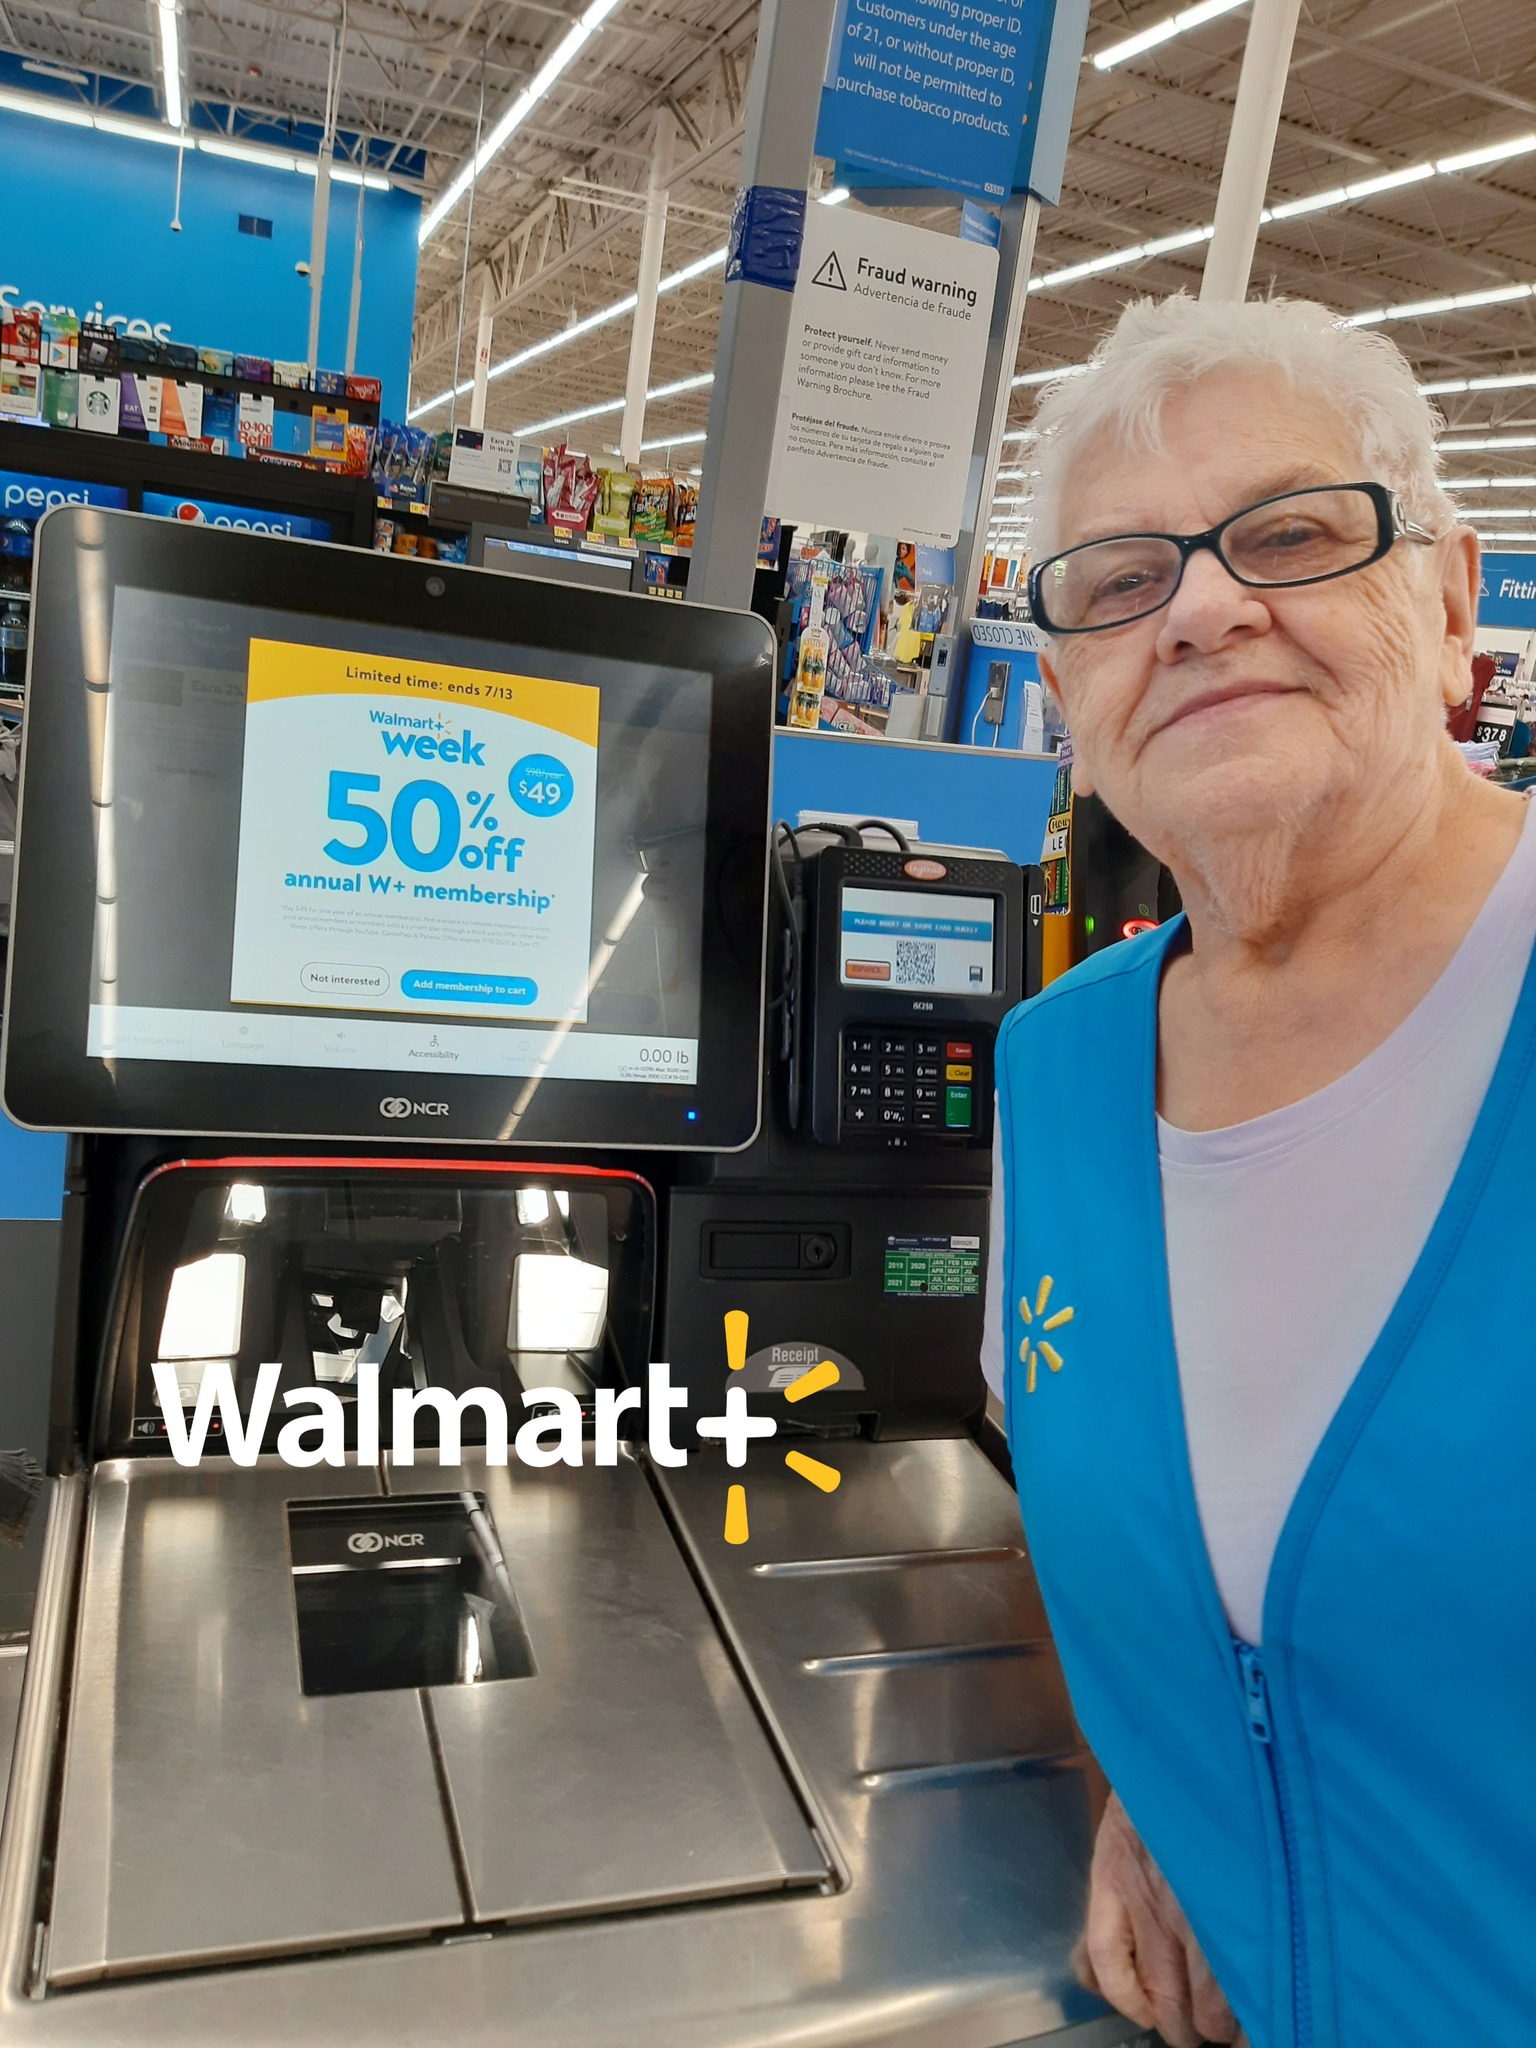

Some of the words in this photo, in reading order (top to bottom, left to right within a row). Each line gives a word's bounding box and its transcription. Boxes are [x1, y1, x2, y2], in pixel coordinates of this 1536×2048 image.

[856, 0, 925, 29] Customers
[929, 21, 967, 41] under
[970, 31, 990, 49] the
[993, 41, 1016, 58] age
[961, 6, 1005, 28] proper
[1007, 16, 1021, 34] ID.
[847, 22, 863, 37] of
[863, 26, 882, 46] 21,
[886, 36, 900, 48] or
[903, 41, 953, 65] without
[955, 57, 998, 78] proper
[1000, 67, 1014, 86] ID,
[854, 53, 876, 70] will
[879, 61, 901, 77] not
[904, 64, 921, 82] be
[923, 75, 987, 102] permitted
[989, 92, 1002, 106] to
[836, 77, 896, 103] purchase
[900, 92, 950, 118] tobacco
[952, 110, 1009, 136] products.
[857, 257, 906, 285] Fraud
[911, 275, 977, 307] warning
[853, 282, 919, 308] Advertencia
[921, 299, 935, 312] de
[937, 302, 971, 320] fraude
[804, 324, 836, 339] Protect
[837, 334, 873, 347] yourself.
[874, 339, 900, 352] Never
[901, 348, 920, 357] send
[921, 352, 949, 366] money
[812, 342, 845, 354] provide
[846, 348, 861, 358] gift
[863, 353, 881, 362] card
[882, 355, 929, 372] information
[931, 366, 940, 375] to
[800, 352, 838, 366] someone
[840, 361, 855, 370] you
[857, 363, 878, 375] don't
[880, 367, 903, 380] know.
[905, 372, 919, 383] For
[920, 378, 941, 388] more
[796, 376, 831, 394] Warning
[832, 384, 872, 400] Brochure.
[798, 363, 847, 381] information
[848, 375, 875, 387] please
[876, 382, 890, 391] see
[892, 384, 905, 394] the
[907, 386, 930, 399] Fraud
[125, 404, 139, 412] EAT
[240, 421, 273, 434] 10-100
[824, 419, 835, 427] del
[836, 421, 859, 432] fraude.
[861, 426, 882, 436] Nunca
[901, 435, 922, 444] dinero
[928, 441, 950, 450] provea
[238, 432, 273, 448] Refill
[789, 423, 799, 431] los
[831, 431, 840, 439] de
[849, 435, 871, 445] tarjeta
[872, 439, 881, 447] de
[882, 442, 903, 451] regalo
[908, 446, 931, 456] alguien
[786, 445, 815, 455] panfleto
[816, 449, 856, 463] Advertencia
[867, 458, 889, 469] fraude.
[5, 484, 90, 508] pepsi
[972, 625, 1014, 645] CLOSED
[346, 666, 400, 683] Limited
[406, 675, 442, 690] time:
[448, 683, 479, 695] ends
[485, 685, 512, 699] 7/13
[381, 730, 486, 766] week
[519, 781, 562, 806] $49
[459, 836, 526, 873] off
[284, 873, 361, 893] annual
[368, 876, 406, 895] W+
[853, 917, 876, 926] PLEASE
[310, 972, 328, 983] Not
[330, 974, 380, 987] interested
[412, 978, 433, 989] Add
[434, 981, 493, 995] membership
[494, 985, 506, 994] to
[507, 986, 526, 995] cart
[408, 1049, 459, 1061] Accessibility
[852, 1041, 857, 1050] 1
[885, 1043, 891, 1052] 2
[918, 1044, 923, 1053] 3
[640, 1048, 672, 1063] 0.00
[676, 1050, 690, 1064] lb
[850, 1064, 857, 1073] 4
[885, 1065, 891, 1075] 5
[917, 1067, 923, 1076] 6
[851, 1086, 857, 1096] 7
[884, 1087, 891, 1097] 8
[916, 1089, 923, 1098] 9
[951, 1091, 967, 1099] Enter
[413, 1103, 449, 1116] NCR
[772, 1347, 820, 1362] Receipt
[385, 1532, 425, 1548] NCR
